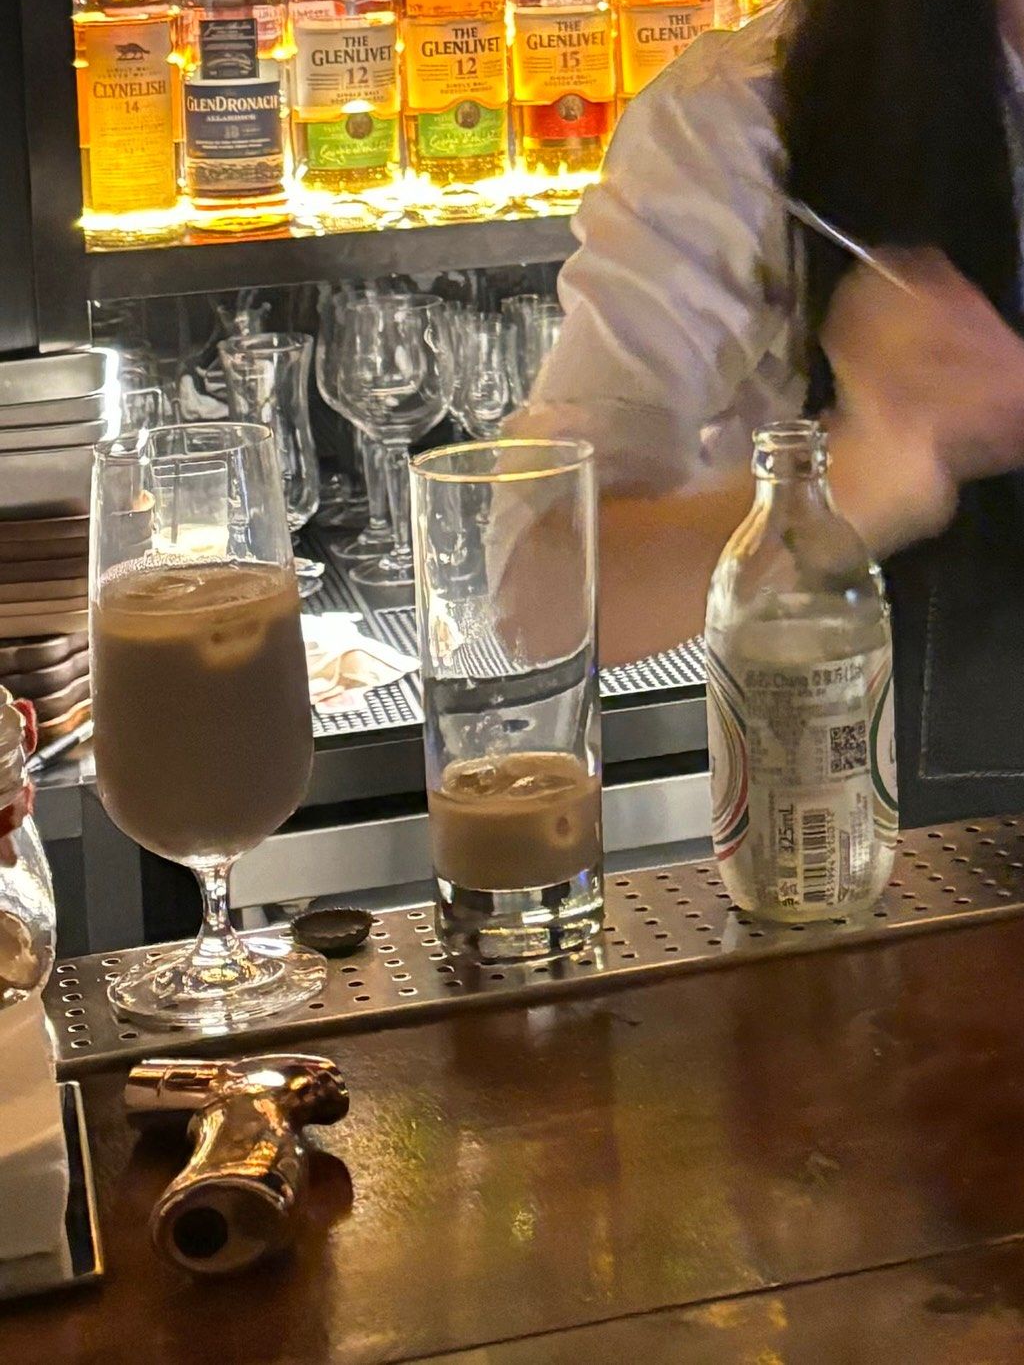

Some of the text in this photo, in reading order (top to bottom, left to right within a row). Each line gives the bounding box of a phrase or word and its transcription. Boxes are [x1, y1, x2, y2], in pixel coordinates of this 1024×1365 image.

[556, 20, 581, 32] THE
[668, 14, 691, 26] THE
[343, 35, 369, 48] THE
[452, 27, 478, 39] THE
[526, 30, 605, 51] GLENLIVET
[421, 36, 501, 57] GLENLIVET
[312, 45, 392, 67] GLENLIVET
[560, 51, 580, 69] 15
[456, 57, 477, 76] 12
[346, 67, 369, 85] 12
[93, 80, 166, 99] CLYNELISH
[125, 100, 139, 114] 14
[187, 94, 279, 112] GLENDRONACH
